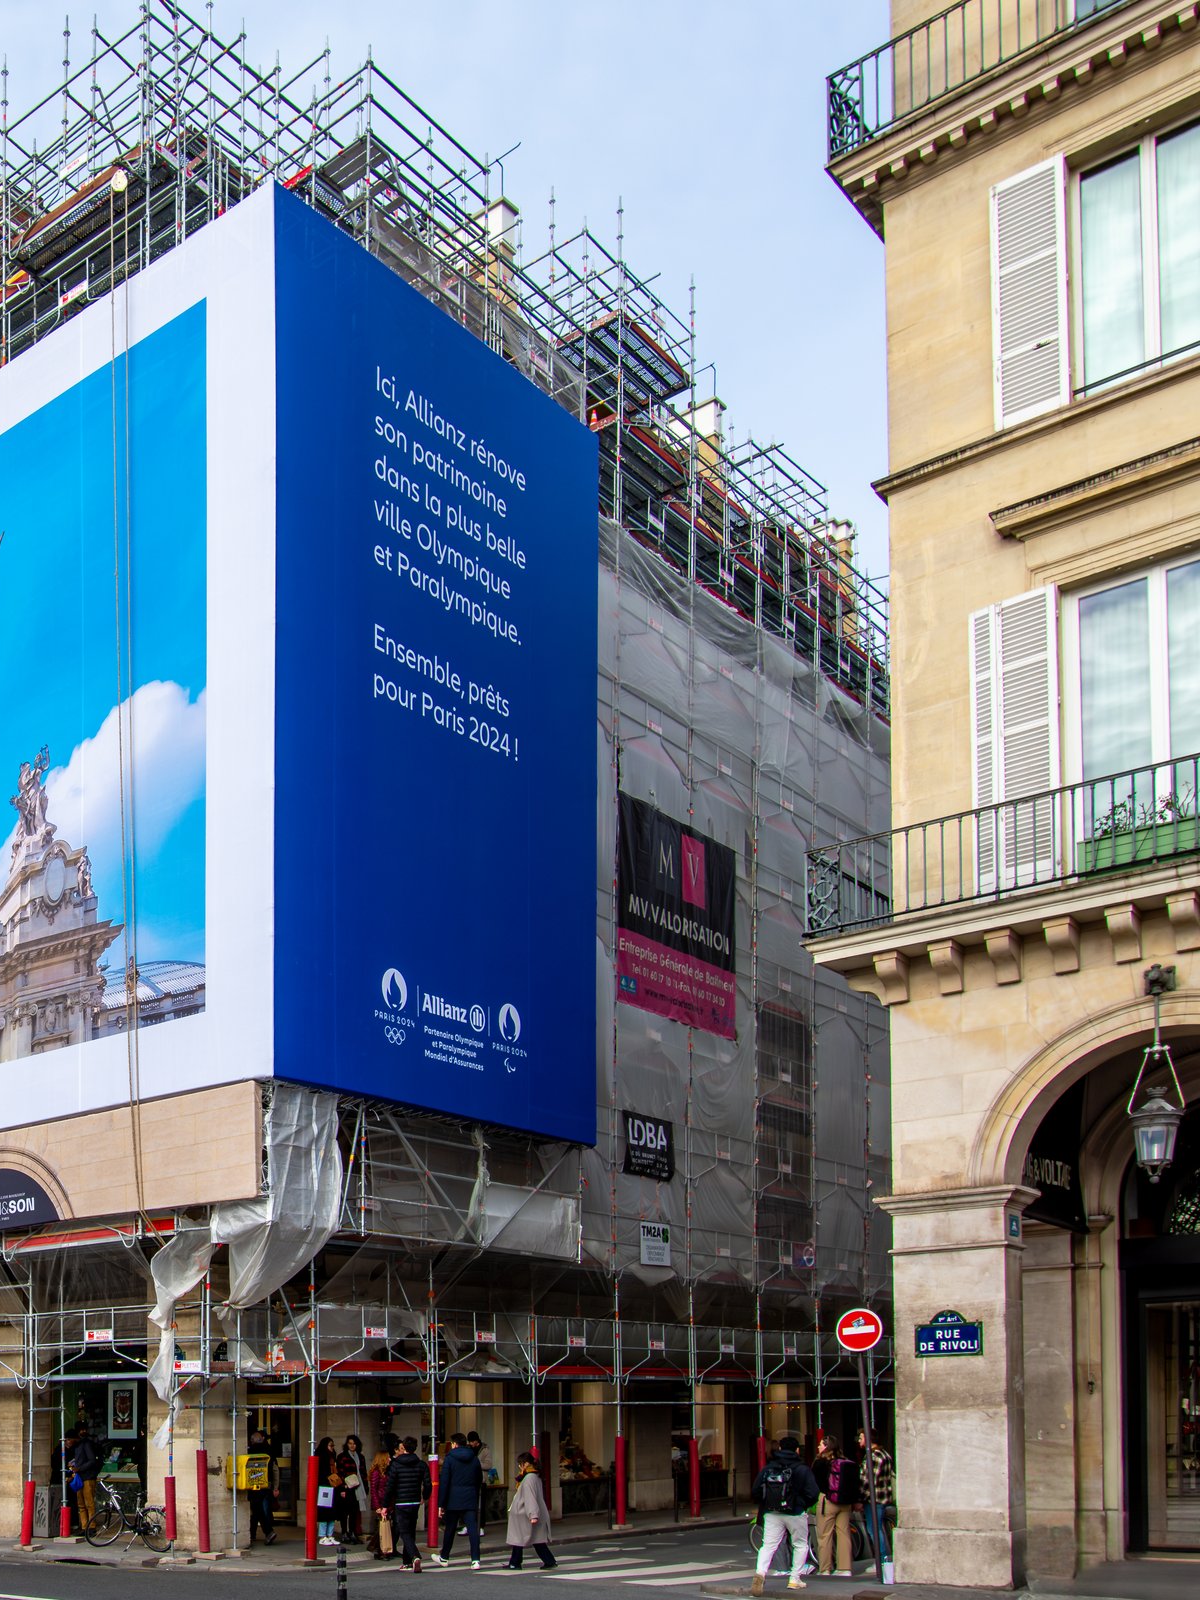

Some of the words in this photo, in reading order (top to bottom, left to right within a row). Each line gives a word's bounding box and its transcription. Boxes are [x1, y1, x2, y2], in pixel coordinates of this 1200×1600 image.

[375, 365, 400, 410] Ici,
[404, 390, 466, 452] Allianz
[470, 438, 527, 492] rénove
[374, 415, 407, 454] son
[412, 441, 508, 518] patrimoine
[374, 455, 420, 502] dans
[424, 491, 441, 518] la
[446, 503, 481, 543] plus
[486, 523, 527, 570] belle
[373, 499, 412, 540] ville
[416, 523, 511, 600] Olympique
[373, 543, 392, 571] et
[397, 551, 522, 646] Paralympique.
[373, 623, 465, 699] Ensemble,
[468, 678, 510, 718] prêts
[373, 672, 417, 712] pour
[421, 691, 465, 736] Paris
[469, 716, 511, 758] 2024
[658, 839, 675, 879] M
[687, 852, 699, 888] V
[619, 937, 658, 963] Entreprise
[694, 967, 704, 982] de
[374, 1009, 395, 1022] PARIS
[396, 1016, 415, 1028] 2024
[422, 993, 467, 1023] Allianz
[424, 1025, 454, 1041] Partenaire
[454, 1034, 484, 1049] Olympique
[431, 1040, 438, 1048] et
[438, 1042, 477, 1058] Paralympique
[492, 1042, 510, 1054] PARIS
[511, 1047, 527, 1058] 2024
[424, 1049, 448, 1063] Mondial
[448, 1056, 484, 1071] d'Assurances
[628, 1117, 667, 1152] LDBA
[641, 1225, 661, 1238] TM2A
[919, 1341, 935, 1351] DE
[940, 1339, 978, 1350] RIVOLI
[936, 1329, 961, 1339] RUE
